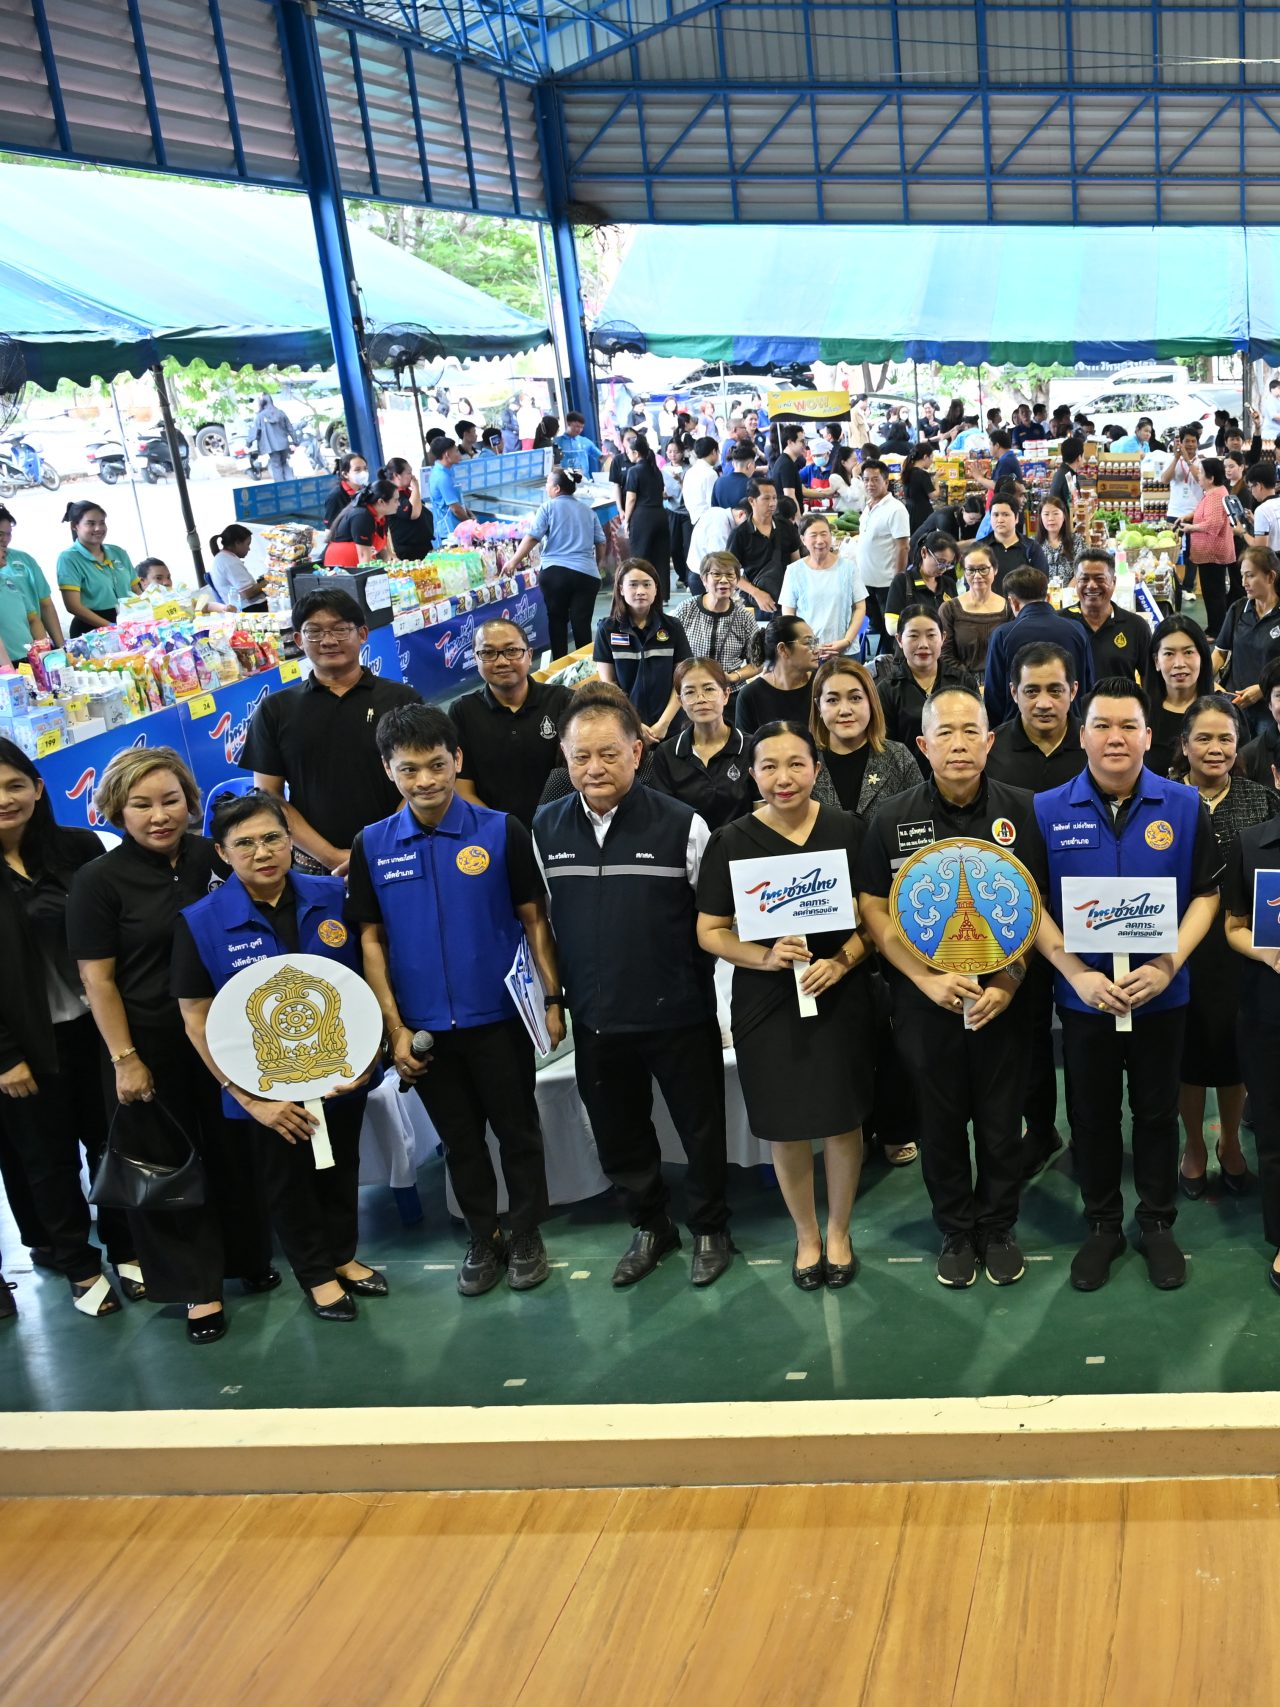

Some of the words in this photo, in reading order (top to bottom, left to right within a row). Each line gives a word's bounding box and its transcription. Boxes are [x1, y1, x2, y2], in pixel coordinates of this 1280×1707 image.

[745, 867, 838, 914] ไทยช่วยไทย
[799, 898, 830, 908] ลดภาระ
[1073, 893, 1165, 930] ไทยช่วยไทย
[1125, 921, 1156, 929] ลดภาระ
